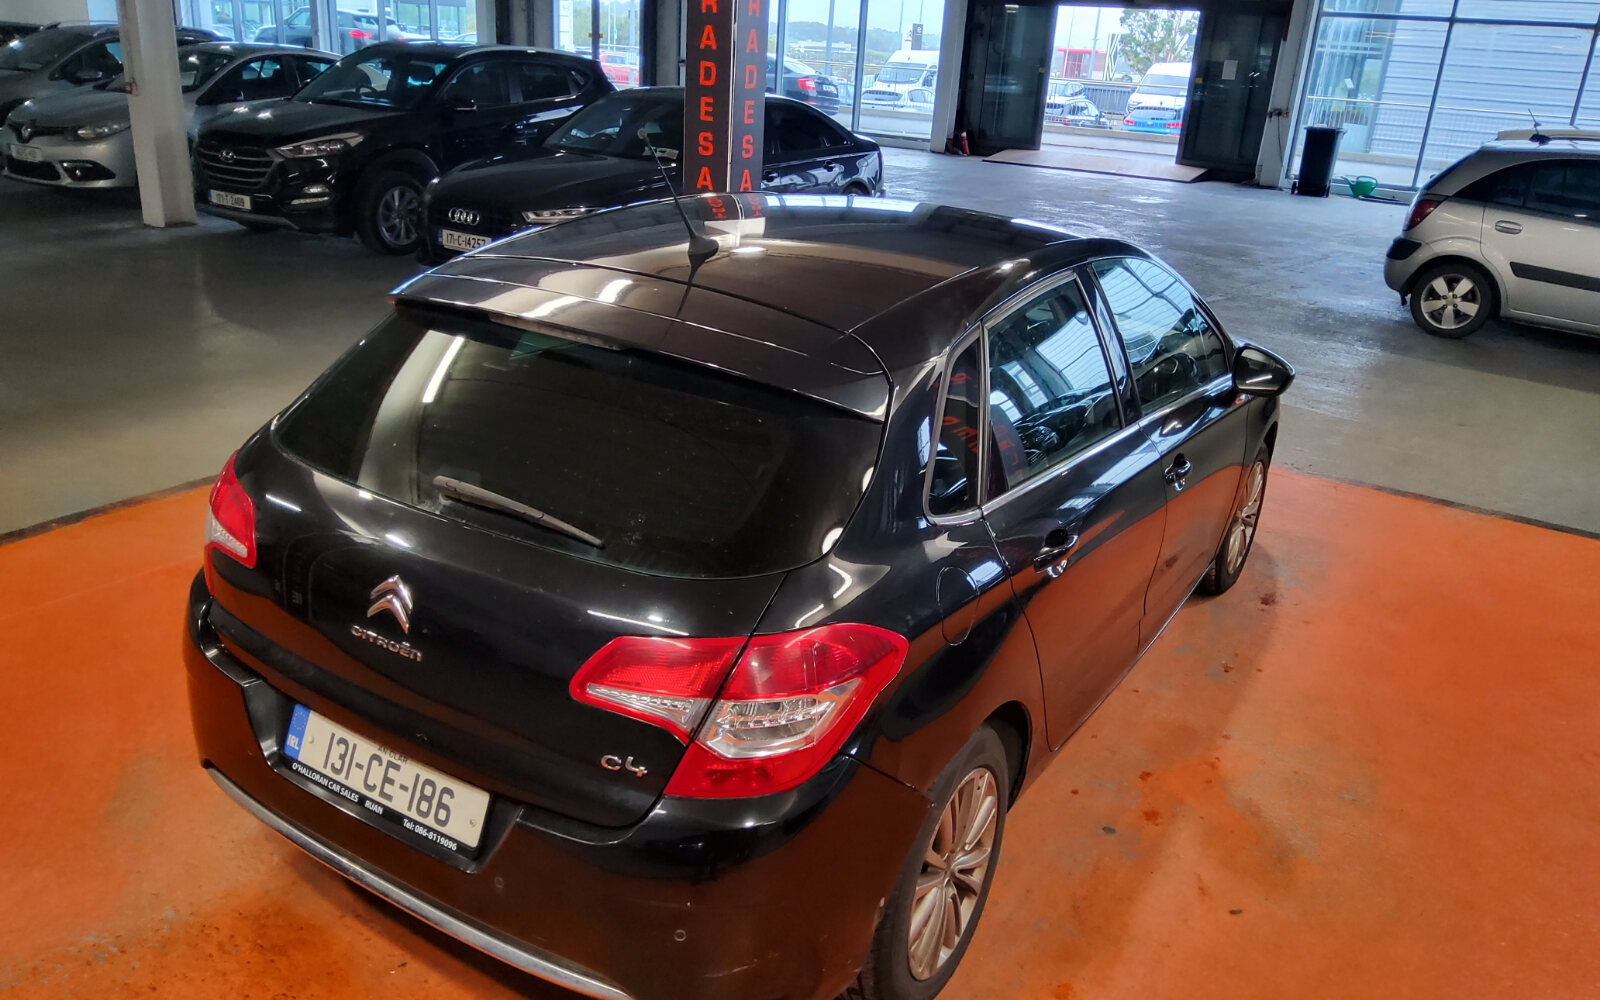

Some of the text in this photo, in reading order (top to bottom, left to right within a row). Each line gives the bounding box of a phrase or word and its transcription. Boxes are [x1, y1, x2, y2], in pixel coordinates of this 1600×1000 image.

[287, 734, 299, 750] IRL
[601, 754, 648, 777] C4
[292, 762, 329, 786] O'HALLORAN
[328, 781, 341, 793] CAR
[340, 787, 359, 802] SALES
[403, 818, 415, 831] Tel:
[414, 824, 458, 851] 086-8119096
[323, 732, 455, 828] 131-CE-186
